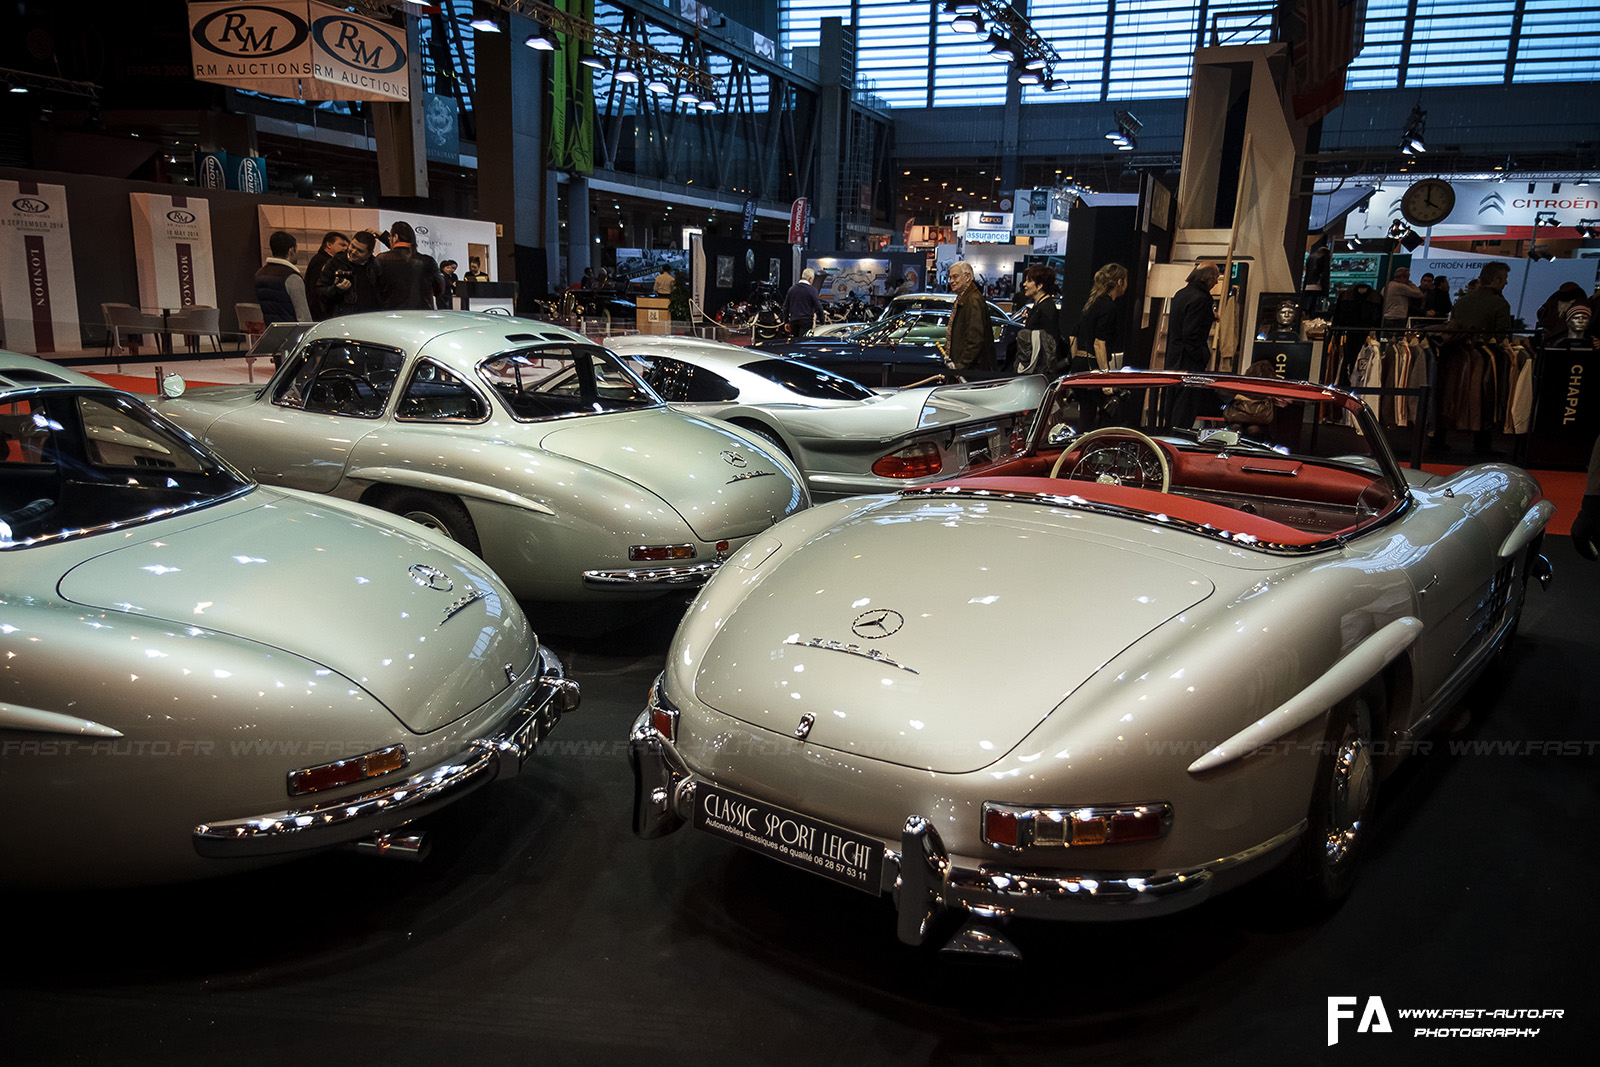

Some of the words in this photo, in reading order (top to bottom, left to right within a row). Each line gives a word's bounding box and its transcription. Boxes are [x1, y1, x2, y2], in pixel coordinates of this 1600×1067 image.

[218, 14, 278, 52] RM
[335, 22, 383, 68] RM
[196, 65, 217, 76] RM
[226, 63, 311, 76] AUCTIONS
[315, 63, 334, 79] RM
[341, 71, 408, 97] AUCTIONS
[1513, 197, 1599, 209] CITROËN
[8, 219, 48, 228] SEPTEMBER
[966, 231, 1009, 241] assurances
[31, 249, 45, 306] LONDON
[180, 255, 192, 306] MONACO
[1429, 261, 1464, 269] CITROËN
[1563, 364, 1584, 425] CHAPAL
[704, 793, 758, 831] CLASSIC
[765, 813, 816, 850] SPORT
[822, 832, 871, 870] LEICHT
[705, 817, 744, 837] Automobiles
[745, 832, 778, 850] classiques
[780, 843, 789, 853] de
[789, 846, 813, 863] qualité
[814, 855, 823, 866] 06
[824, 859, 834, 870] 28
[835, 862, 845, 873] 57
[846, 866, 857, 877] 53
[858, 871, 867, 881] 11
